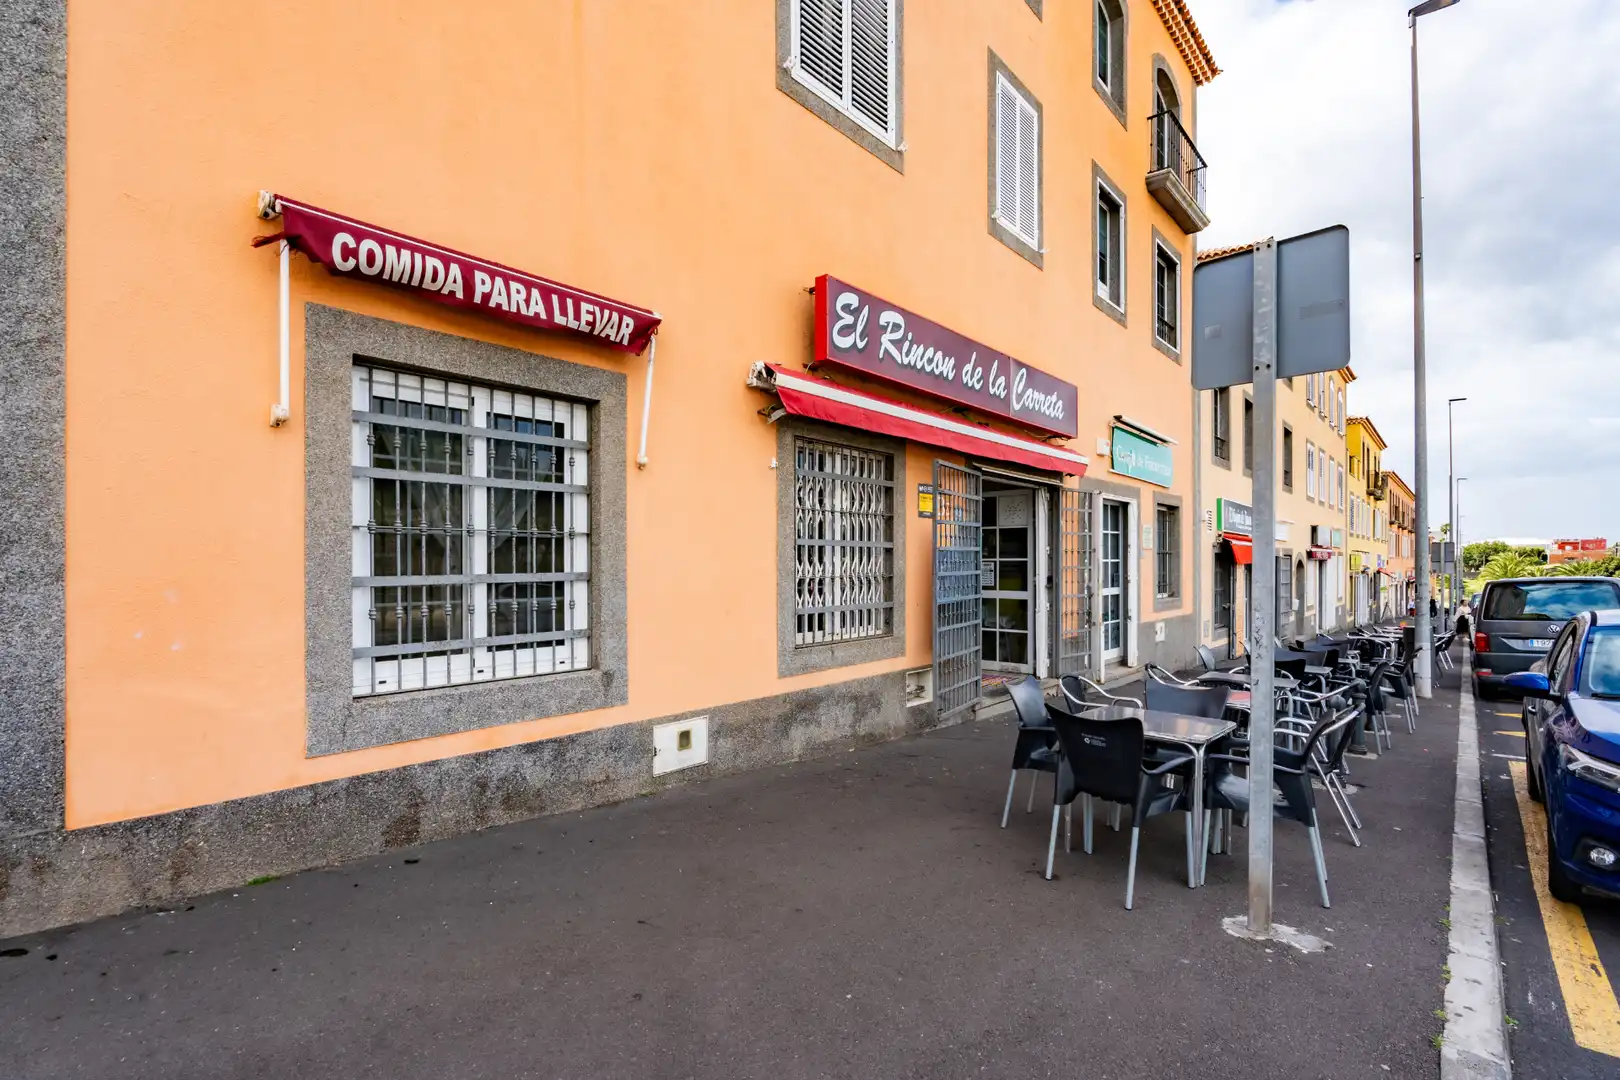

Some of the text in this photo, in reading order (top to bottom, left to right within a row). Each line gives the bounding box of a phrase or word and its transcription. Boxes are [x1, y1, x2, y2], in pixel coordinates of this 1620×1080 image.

[332, 232, 634, 346] COMIDA PARA LLEVAR
[832, 292, 1064, 419] El Rincon de la Carreta
